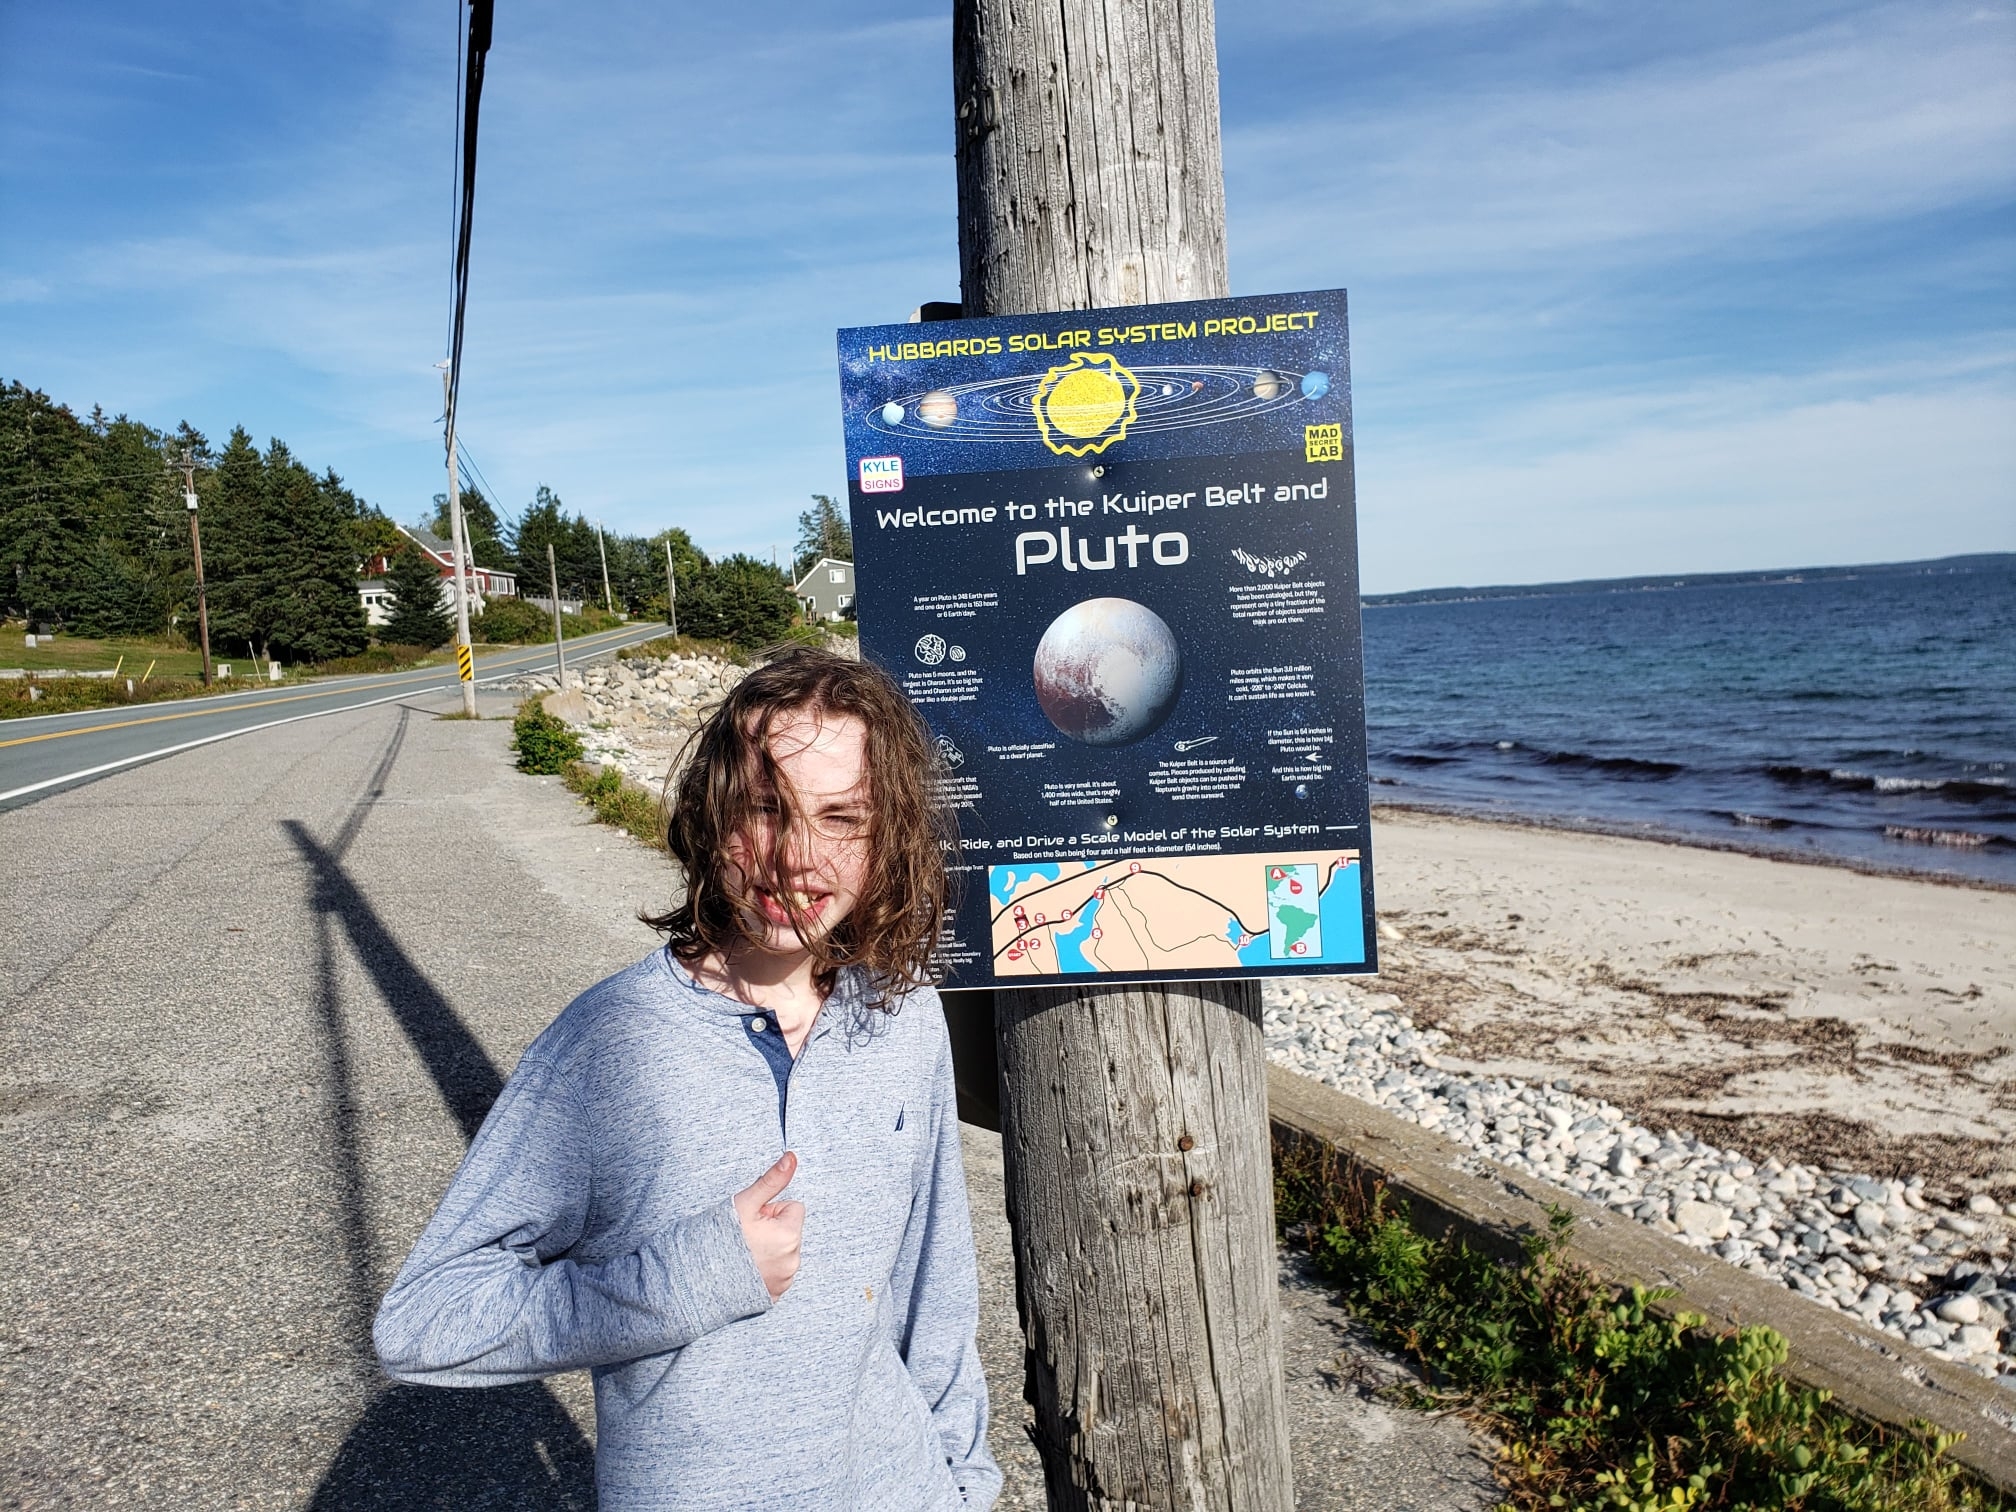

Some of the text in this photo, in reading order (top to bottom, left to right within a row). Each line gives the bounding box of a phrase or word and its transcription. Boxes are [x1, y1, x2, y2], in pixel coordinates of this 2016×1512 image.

[869, 311, 1318, 362] HUBBARDS SOLAR SYSTEM PROJECT
[1309, 429, 1337, 439] MAD
[1310, 446, 1338, 457] LAB
[864, 460, 899, 472] KYLE
[865, 479, 899, 489] SIGNS
[877, 477, 1328, 529] Welcome to the Kuiper Belt and
[1016, 525, 1188, 575] Pluto
[1239, 774, 1245, 782] by
[960, 824, 1319, 850] Ride, and Drive a Scale Model of the Solar System
[1068, 849, 1086, 857] being
[1197, 843, 1222, 851] inches).
[1337, 858, 1348, 866] 11
[1132, 864, 1139, 872] 9
[1273, 870, 1281, 878] A
[1096, 890, 1103, 898] 7
[1064, 911, 1070, 919] 6
[1240, 936, 1249, 944] 10
[1020, 941, 1025, 949] 1
[1297, 944, 1305, 952] B
